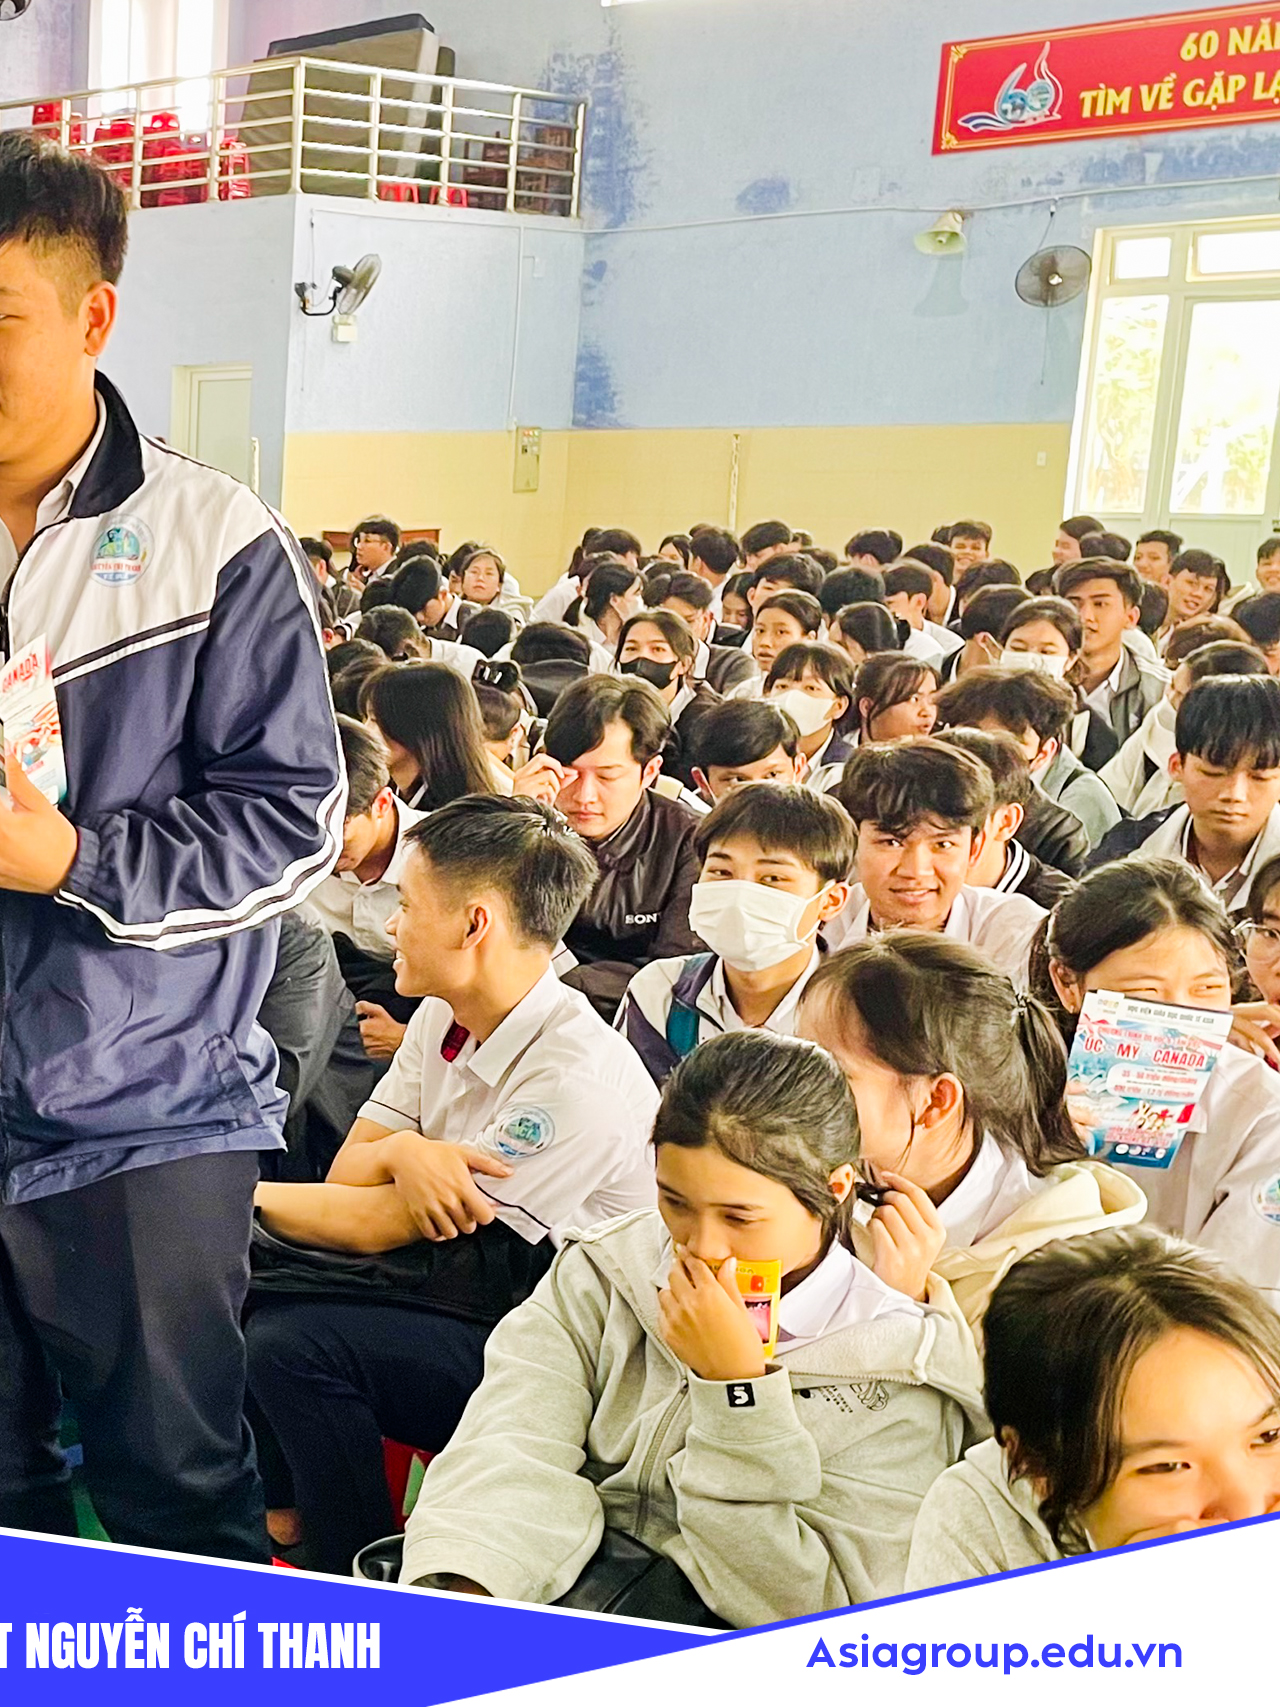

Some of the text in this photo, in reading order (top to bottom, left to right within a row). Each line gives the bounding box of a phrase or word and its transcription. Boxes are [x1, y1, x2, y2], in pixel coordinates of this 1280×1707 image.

[1180, 29, 1219, 61] 60
[1079, 83, 1132, 118] TÌM
[1140, 72, 1177, 112] VỀ
[1183, 70, 1246, 111] GẶP
[1153, 1049, 1205, 1067] CANADA
